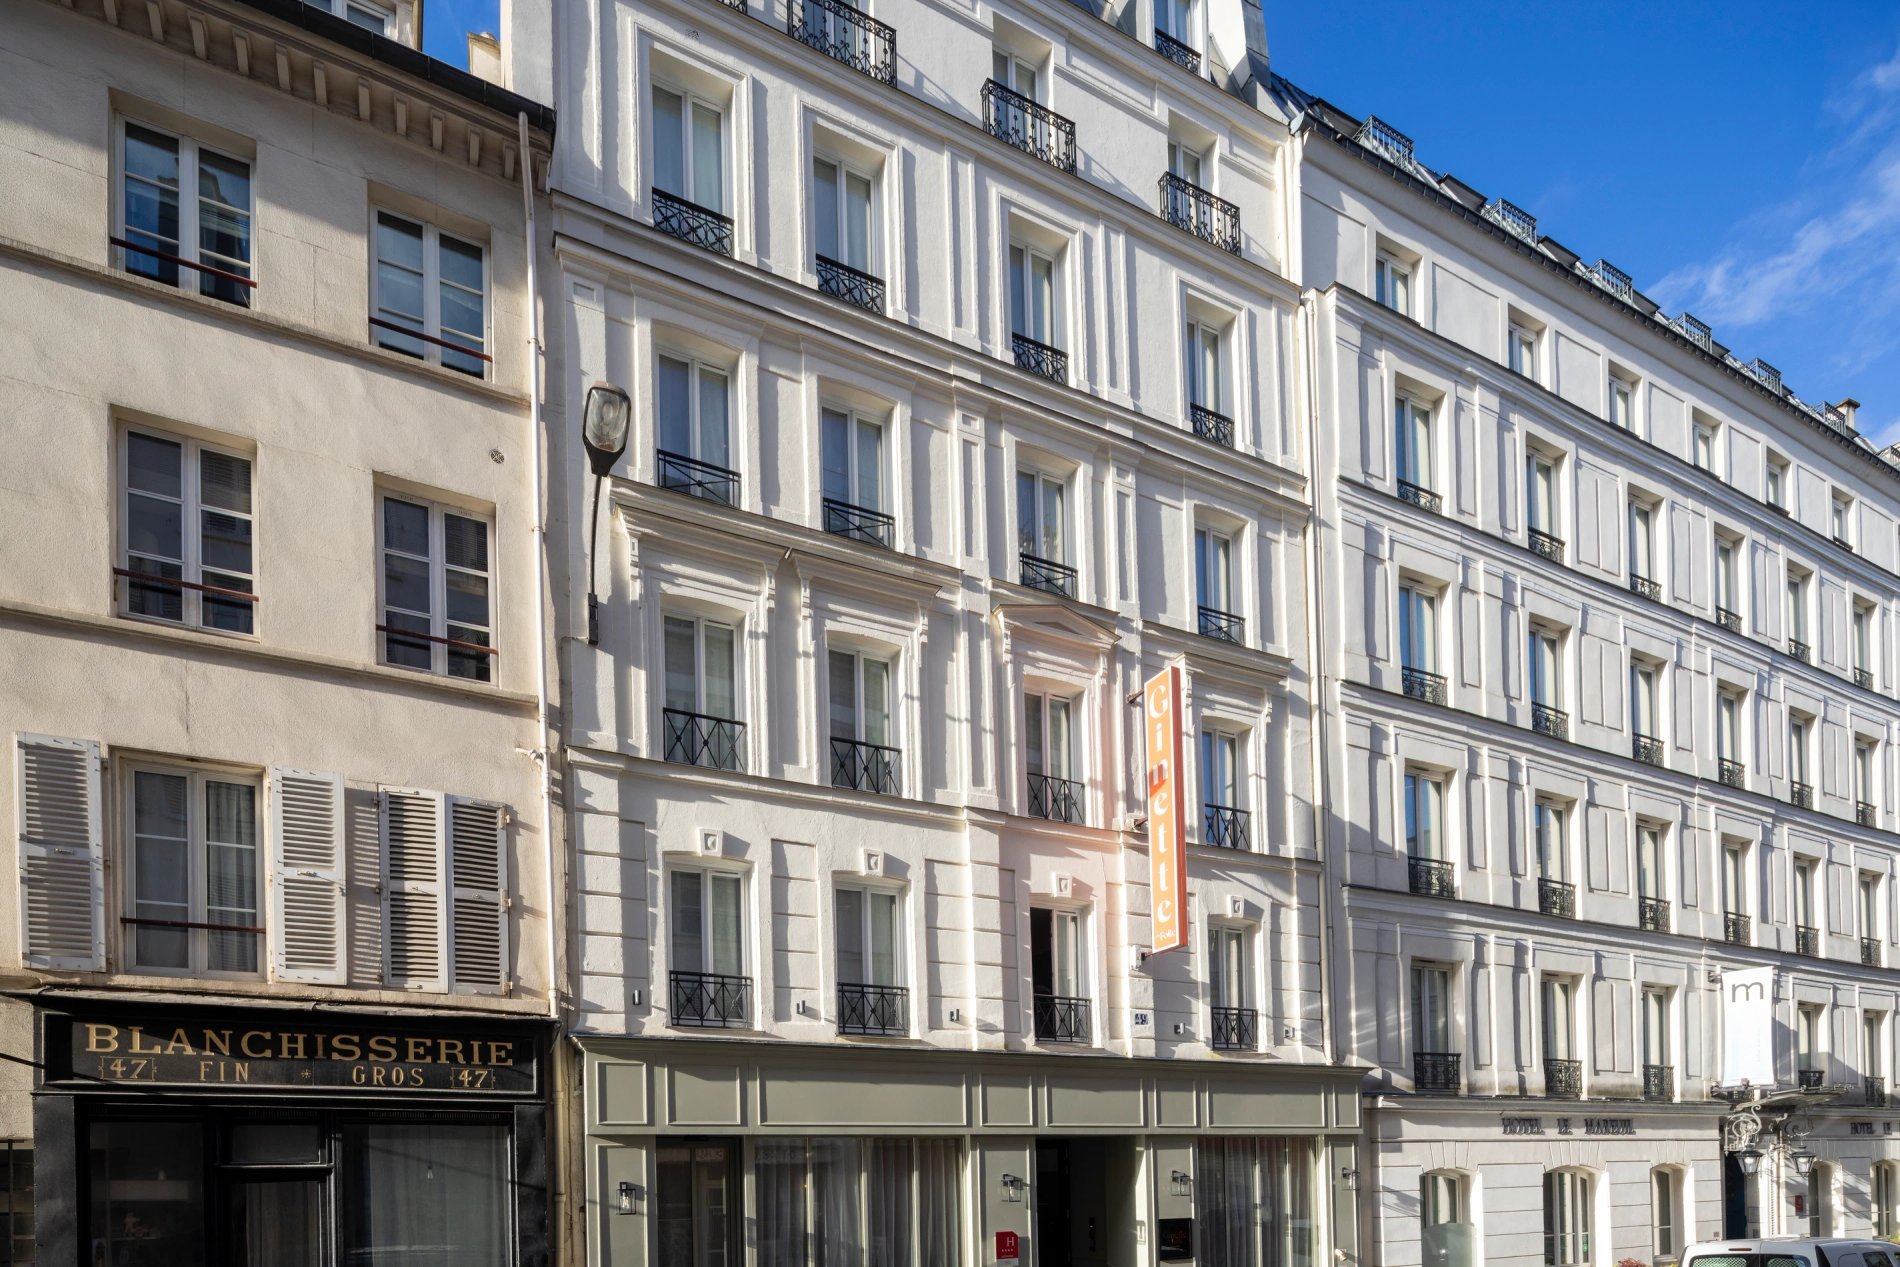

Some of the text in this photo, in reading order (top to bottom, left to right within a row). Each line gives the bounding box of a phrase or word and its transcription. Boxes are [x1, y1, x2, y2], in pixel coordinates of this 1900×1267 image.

[1149, 685, 1173, 923] Ginette
[1731, 981, 1764, 1003] m
[1135, 1013, 1149, 1025] 49
[85, 1023, 513, 1066] BLANCHISSERIE
[110, 1058, 488, 1088] 47 FIN GROS 47
[1502, 1117, 1545, 1135] HOTEL
[1557, 1117, 1573, 1135] LE
[1850, 1121, 1875, 1135] HOTEL
[1006, 1236, 1015, 1247] H
